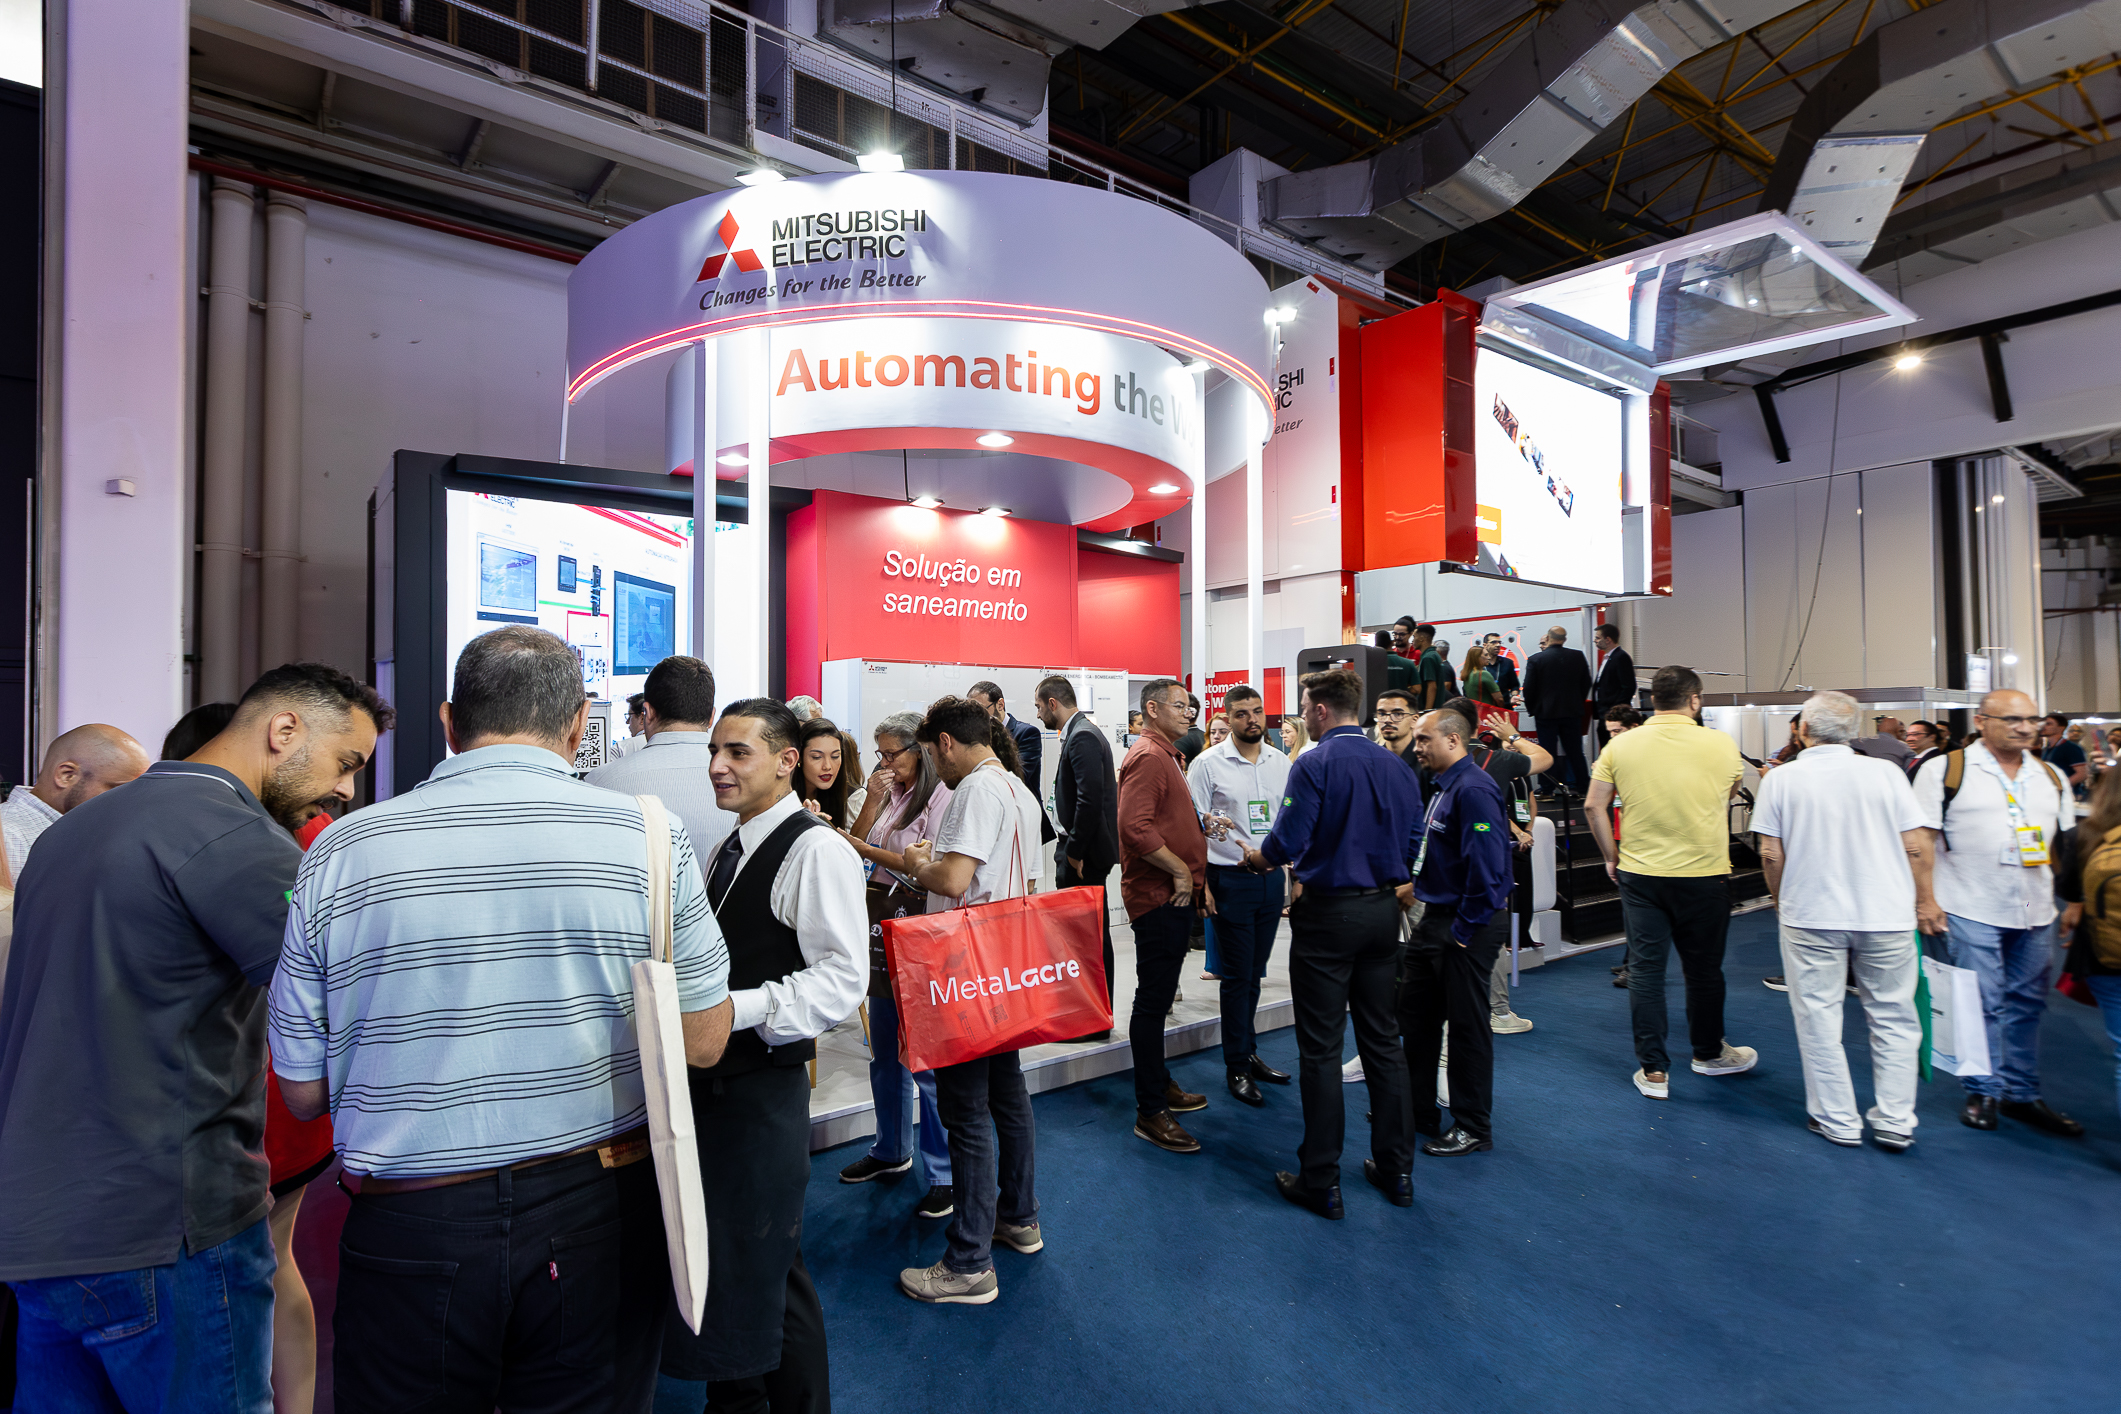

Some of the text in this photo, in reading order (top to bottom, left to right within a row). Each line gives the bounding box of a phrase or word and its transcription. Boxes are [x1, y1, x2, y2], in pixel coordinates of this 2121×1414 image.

[772, 209, 926, 241] MITSUBISHI
[772, 235, 906, 267] ELECTRIC
[699, 269, 927, 310] Changes for the Better
[776, 348, 1101, 415] Automating
[1114, 371, 1164, 426] the
[1274, 419, 1303, 435] etter
[883, 550, 1022, 588] Solução em
[883, 593, 1028, 621] saneamento
[929, 959, 1080, 1006] MetaLacre
